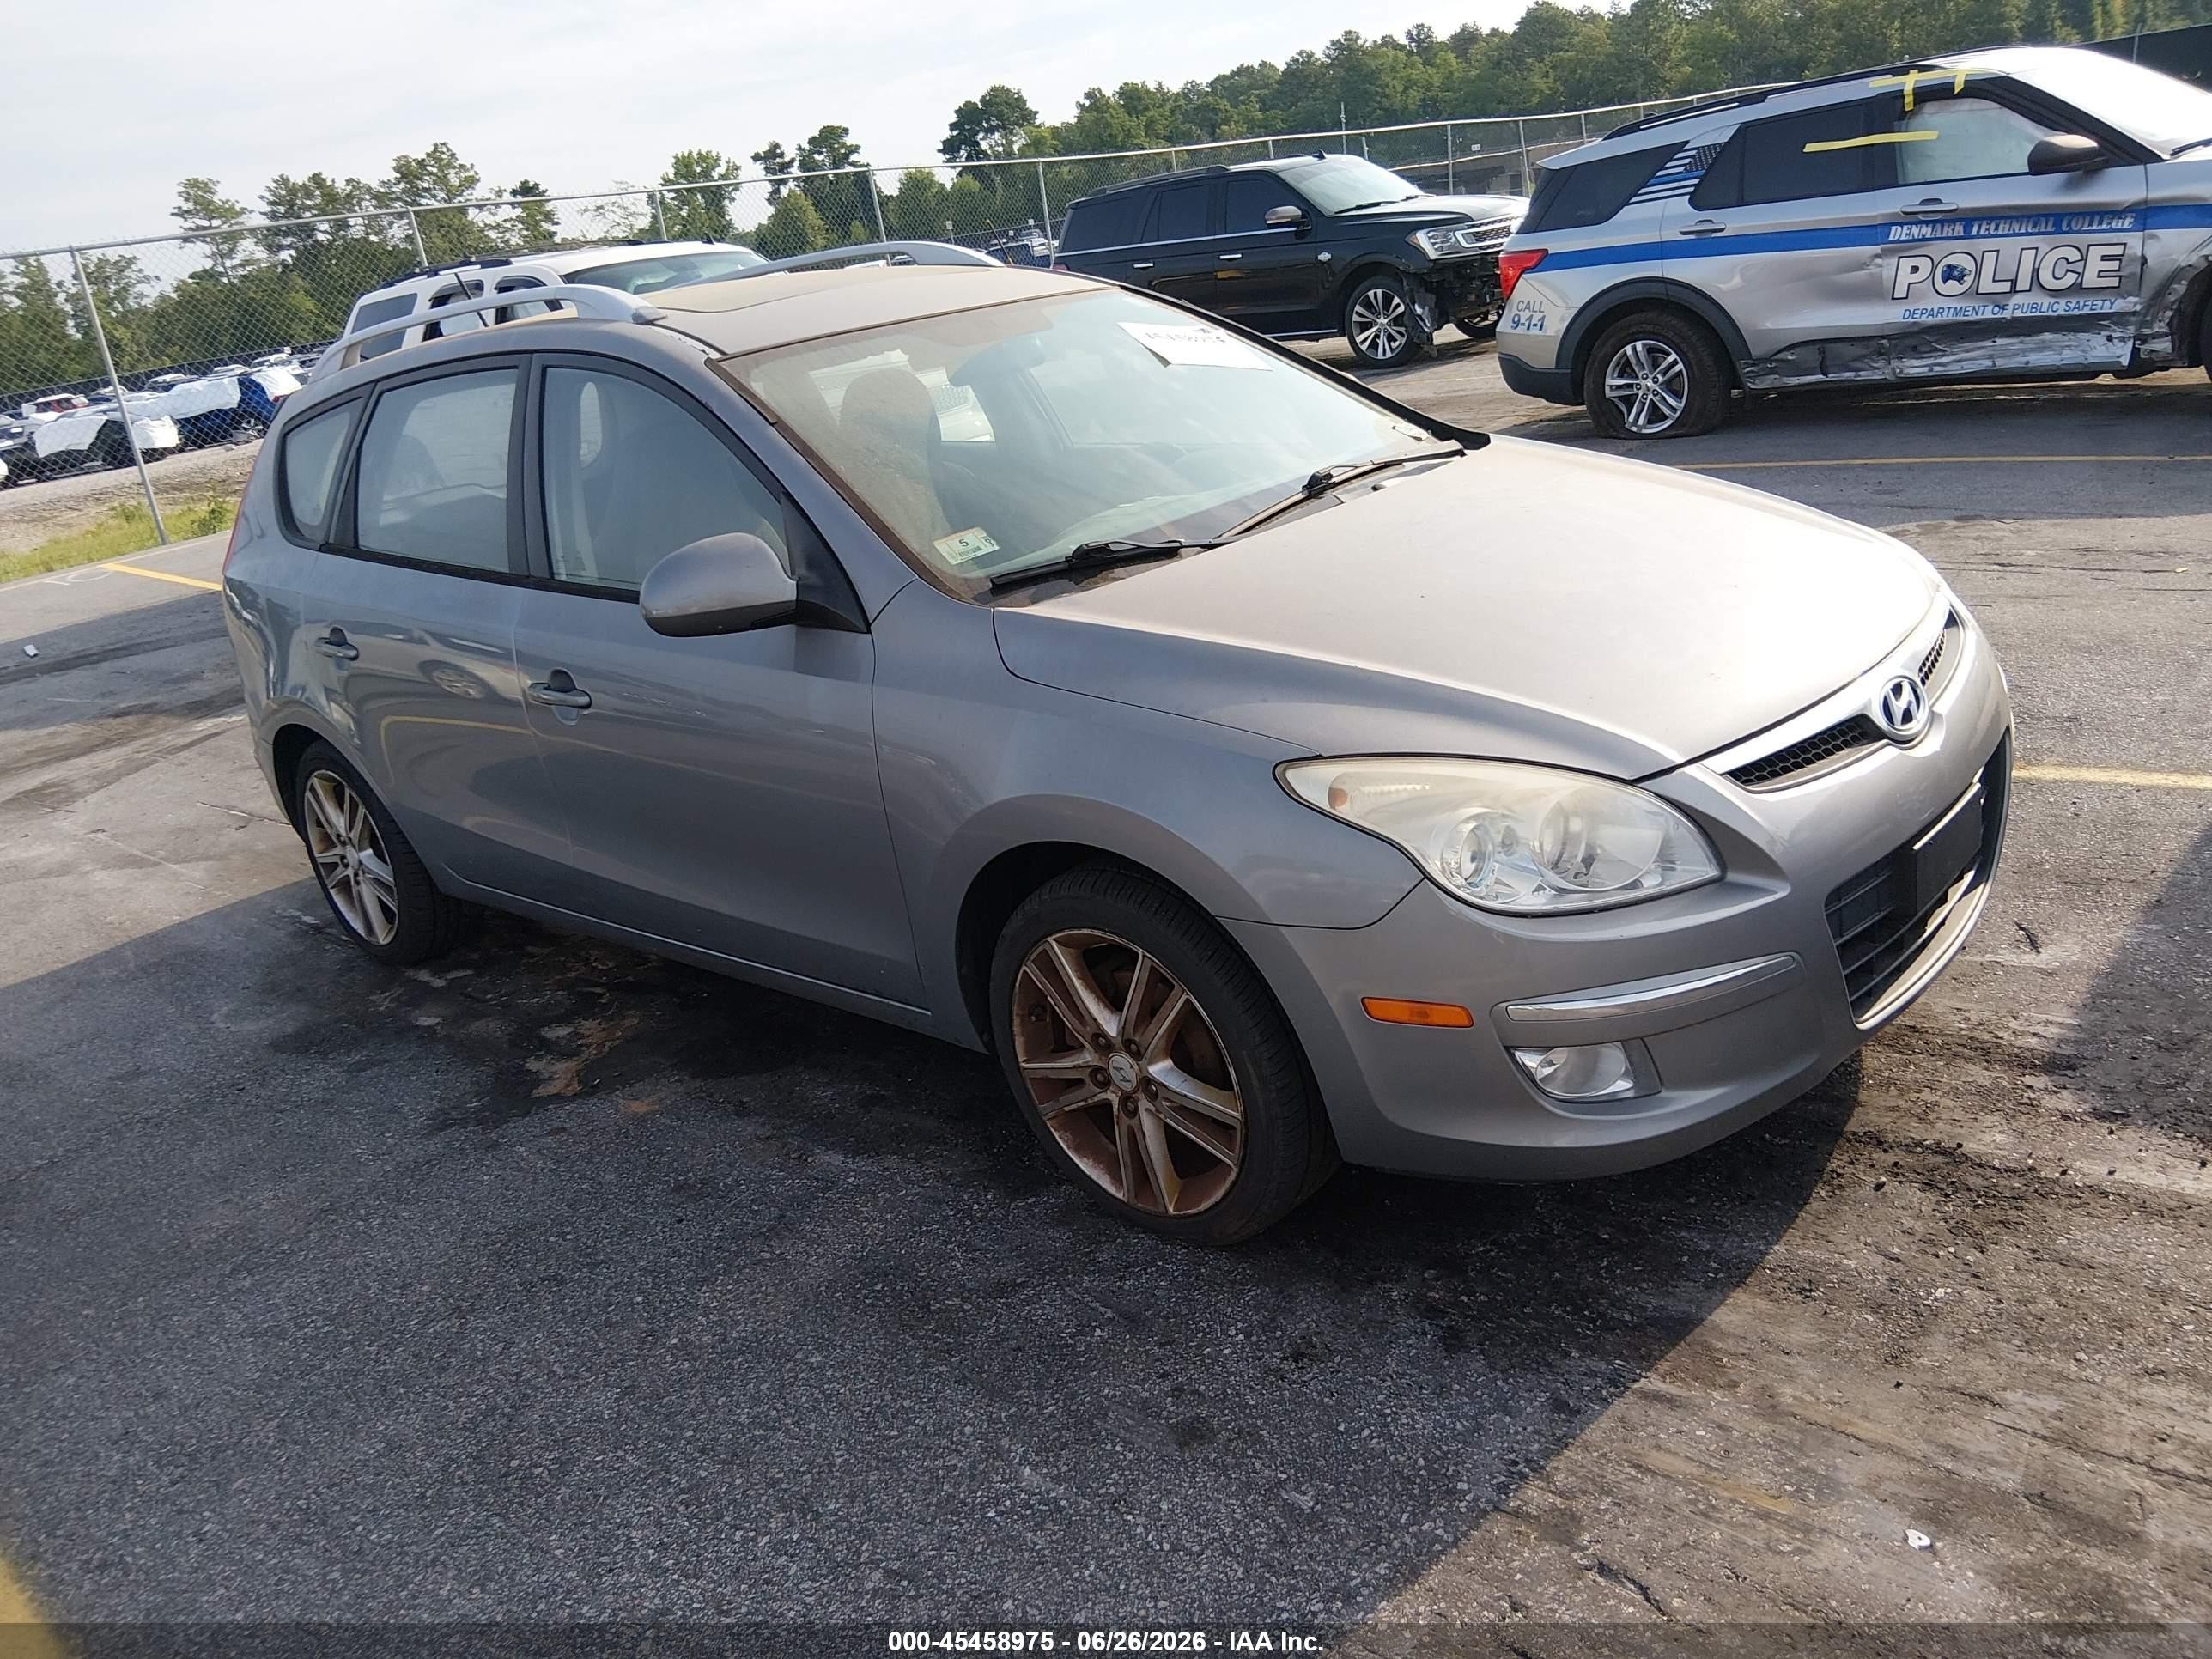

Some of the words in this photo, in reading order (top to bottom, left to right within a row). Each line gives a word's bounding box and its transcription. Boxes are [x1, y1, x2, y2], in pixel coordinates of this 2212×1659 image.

[1888, 222, 1965, 240] DENMARK
[1971, 216, 2057, 235] TECHNICAL
[2061, 212, 2136, 232] COLLEGE
[1892, 242, 2127, 300] POLICE
[1516, 300, 1545, 313] CALL
[1902, 305, 1989, 320] DEPARTMENT
[1992, 304, 2009, 316] OF
[2012, 301, 2060, 314] PUBLIC
[2063, 298, 2118, 313] SAFETY
[1510, 313, 1546, 331] 9-1-1
